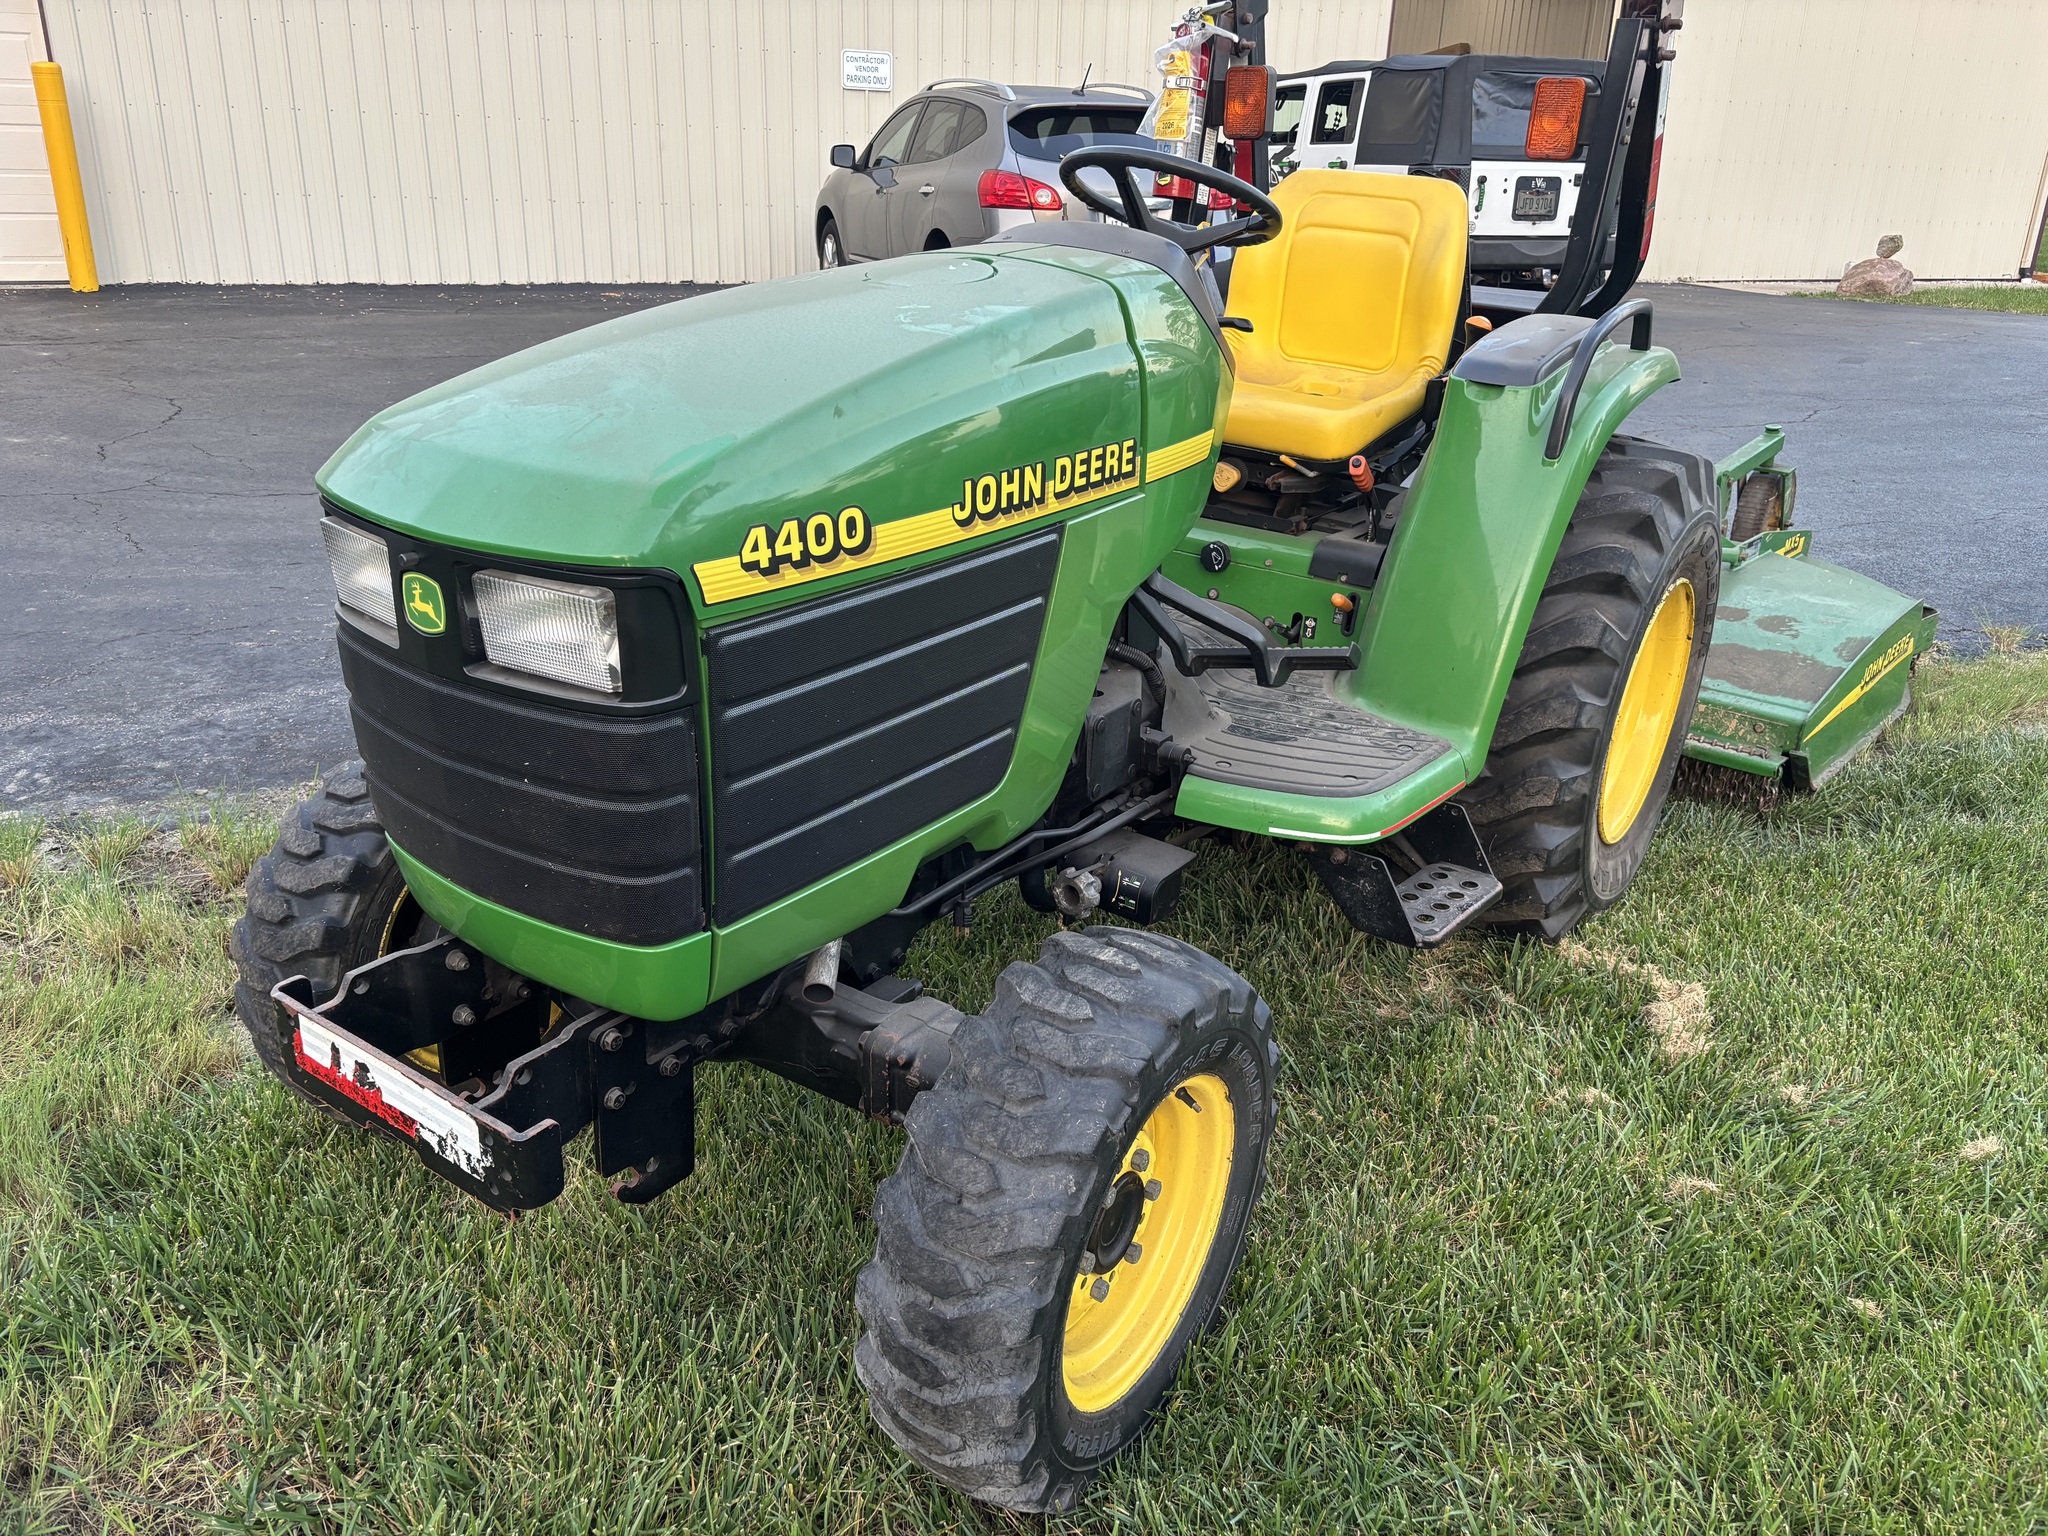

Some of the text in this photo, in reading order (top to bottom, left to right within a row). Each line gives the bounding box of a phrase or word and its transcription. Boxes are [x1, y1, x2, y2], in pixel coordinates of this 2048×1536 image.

[846, 55, 885, 64] CONTRACTOR
[855, 65, 879, 73] VENDOR
[846, 74, 888, 85] PARKING ONLY
[951, 438, 1137, 525] JOHN DEERE
[740, 506, 868, 571] 4400
[1783, 533, 1801, 552] MX5
[1859, 630, 1913, 686] JOHN DEERE
[1227, 1041, 1263, 1147] LOADER
[1060, 1422, 1122, 1459] TITAN
